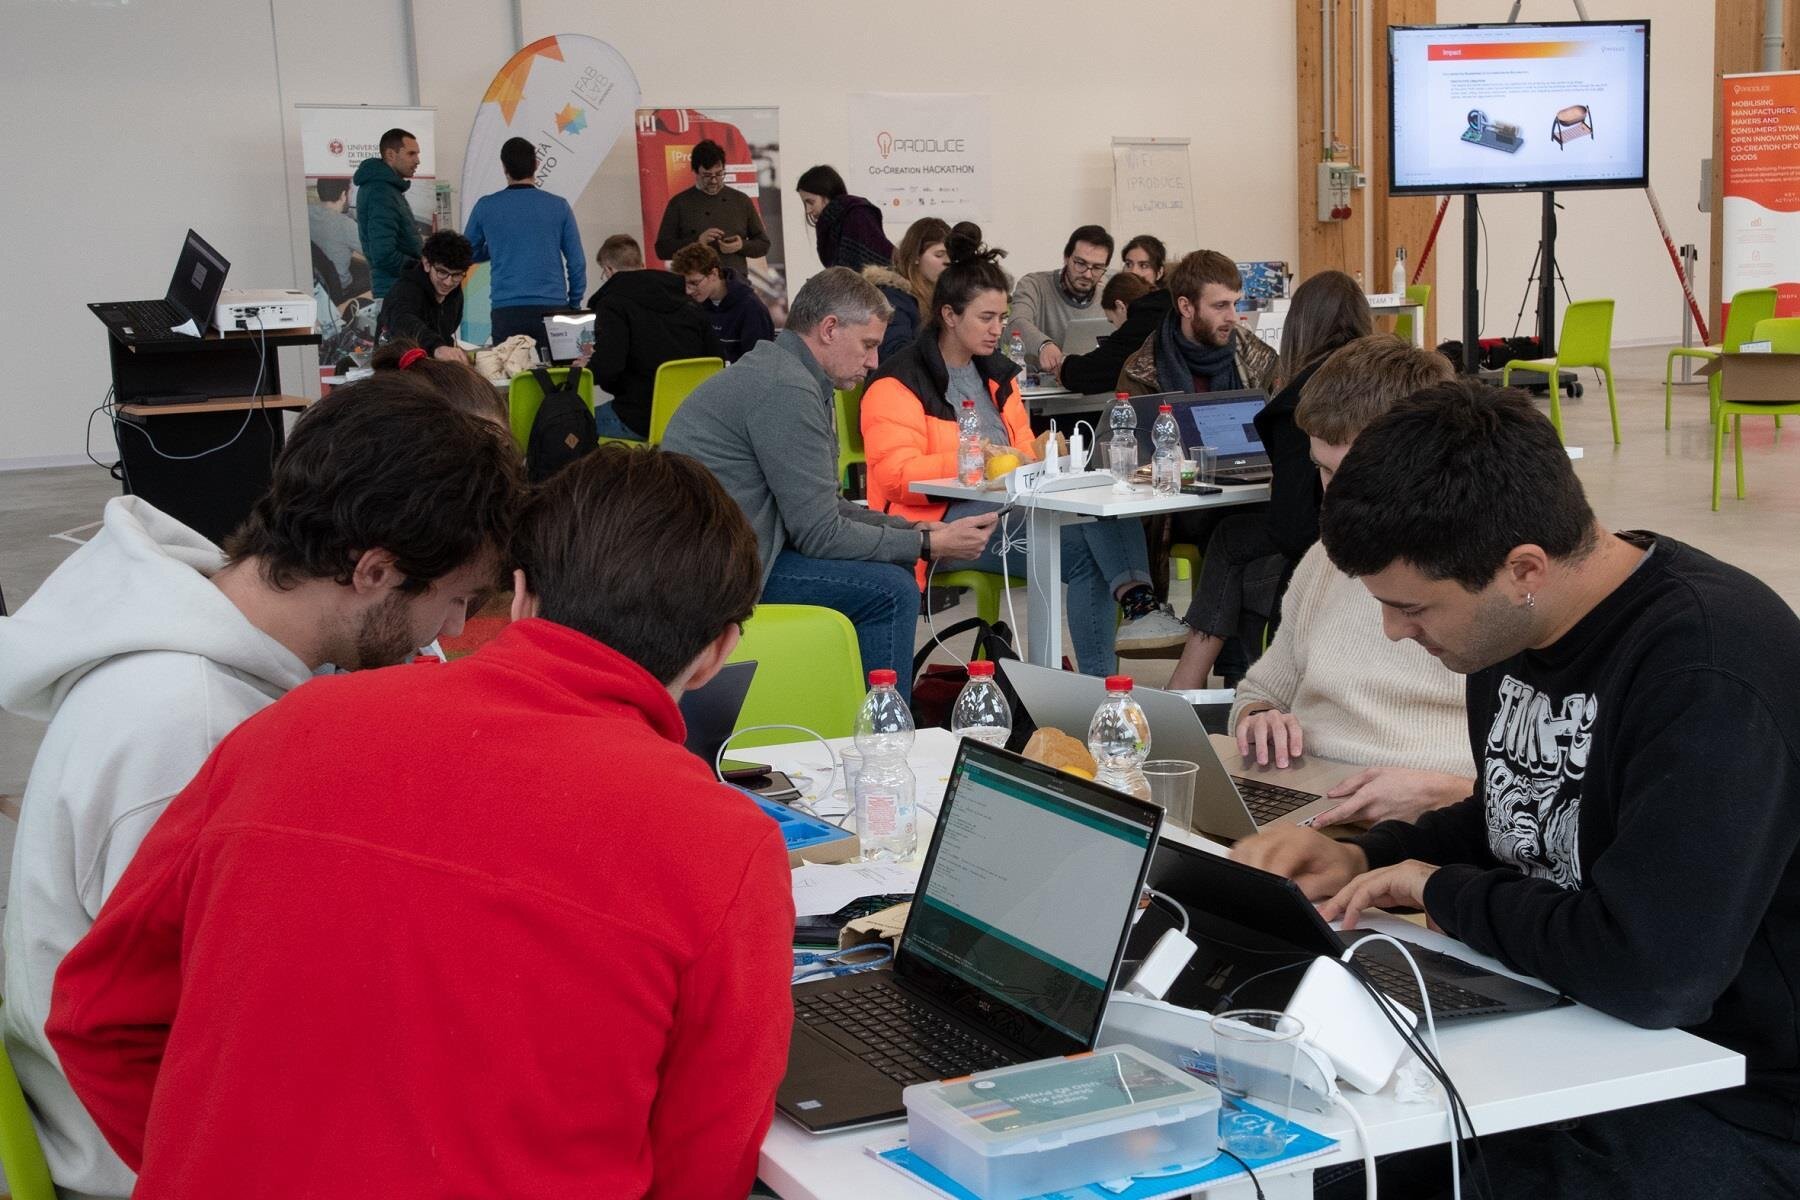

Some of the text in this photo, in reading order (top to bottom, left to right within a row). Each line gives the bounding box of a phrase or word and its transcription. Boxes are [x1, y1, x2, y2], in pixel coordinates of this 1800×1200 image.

[1442, 49, 1462, 57] Impact
[573, 65, 598, 93] FAB
[1731, 99, 1774, 107] MOBILISING
[1731, 107, 1797, 116] MANUFACTURERS,
[1731, 118, 1761, 126] MAKERS
[1731, 126, 1777, 134] CONSUMERS
[1753, 134, 1799, 142] INNOVATION
[347, 143, 380, 152] UNIVERSI
[894, 138, 965, 153] PRODUCE
[1731, 143, 1780, 152] CO-CREATION
[922, 164, 975, 174] HACKATHON
